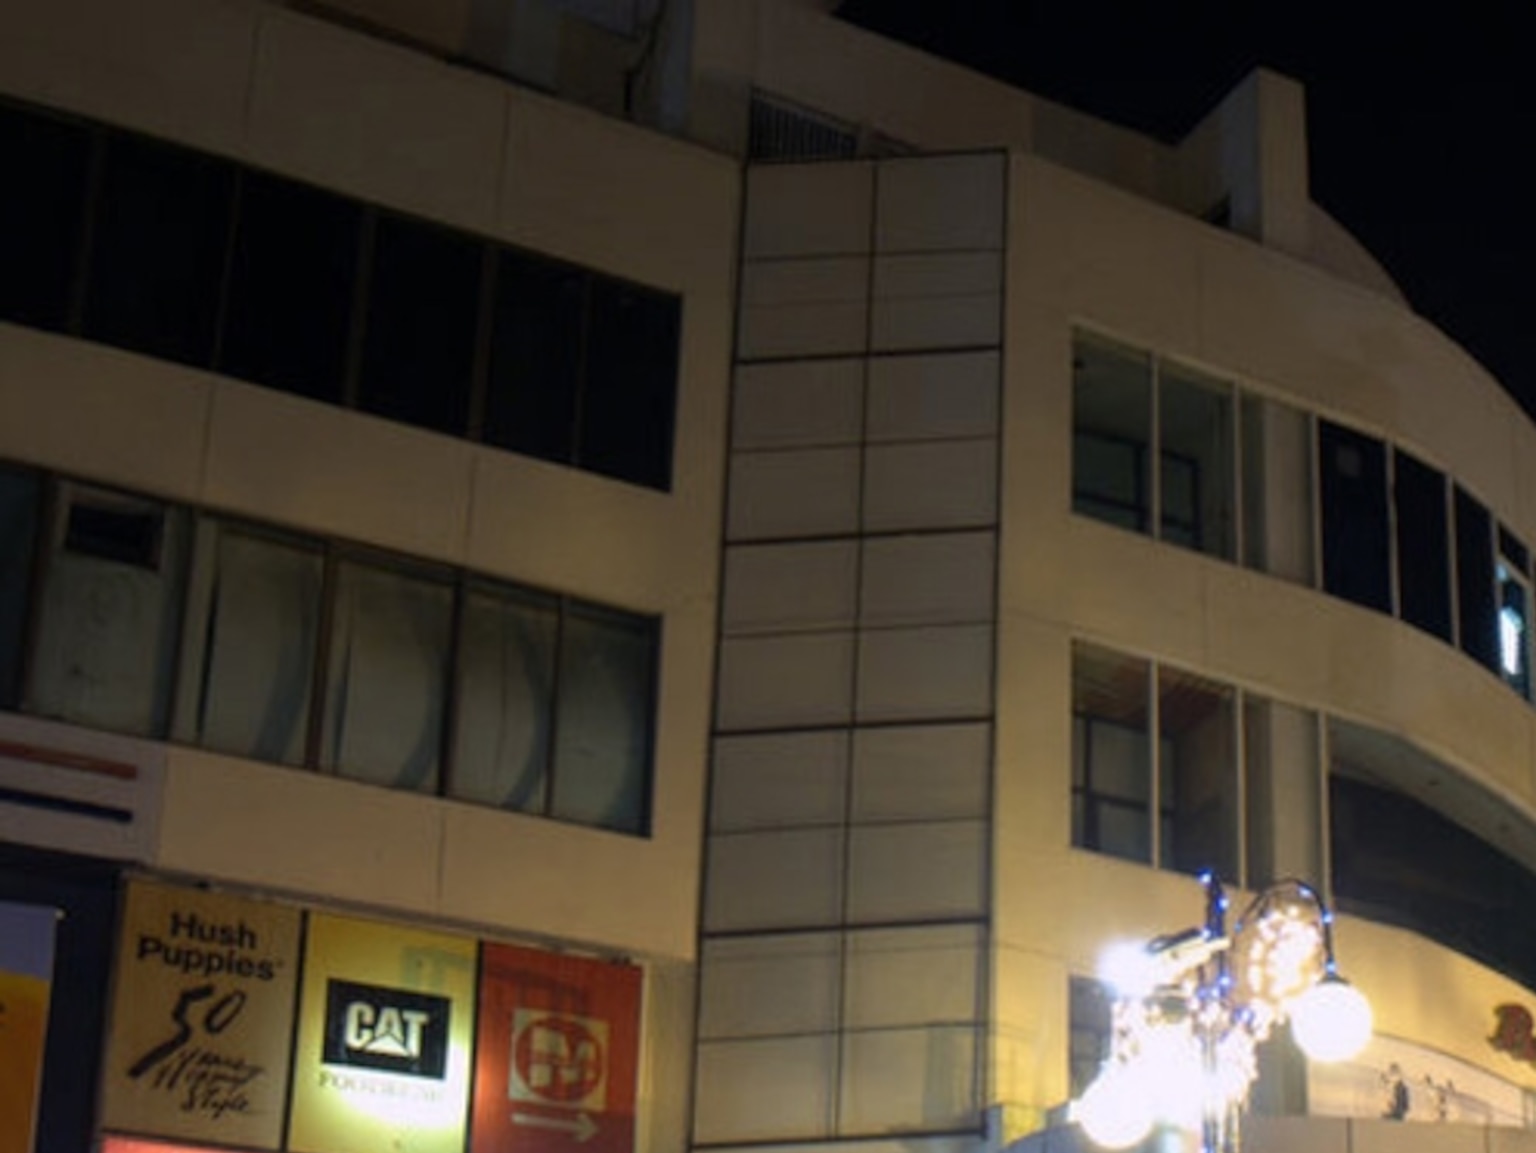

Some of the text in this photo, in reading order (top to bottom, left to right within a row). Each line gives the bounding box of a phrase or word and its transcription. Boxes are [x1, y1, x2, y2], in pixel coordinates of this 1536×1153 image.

[170, 912, 257, 949] Hush
[136, 935, 275, 981] Puppies
[127, 984, 246, 1079] 50
[345, 1001, 430, 1059] CAT
